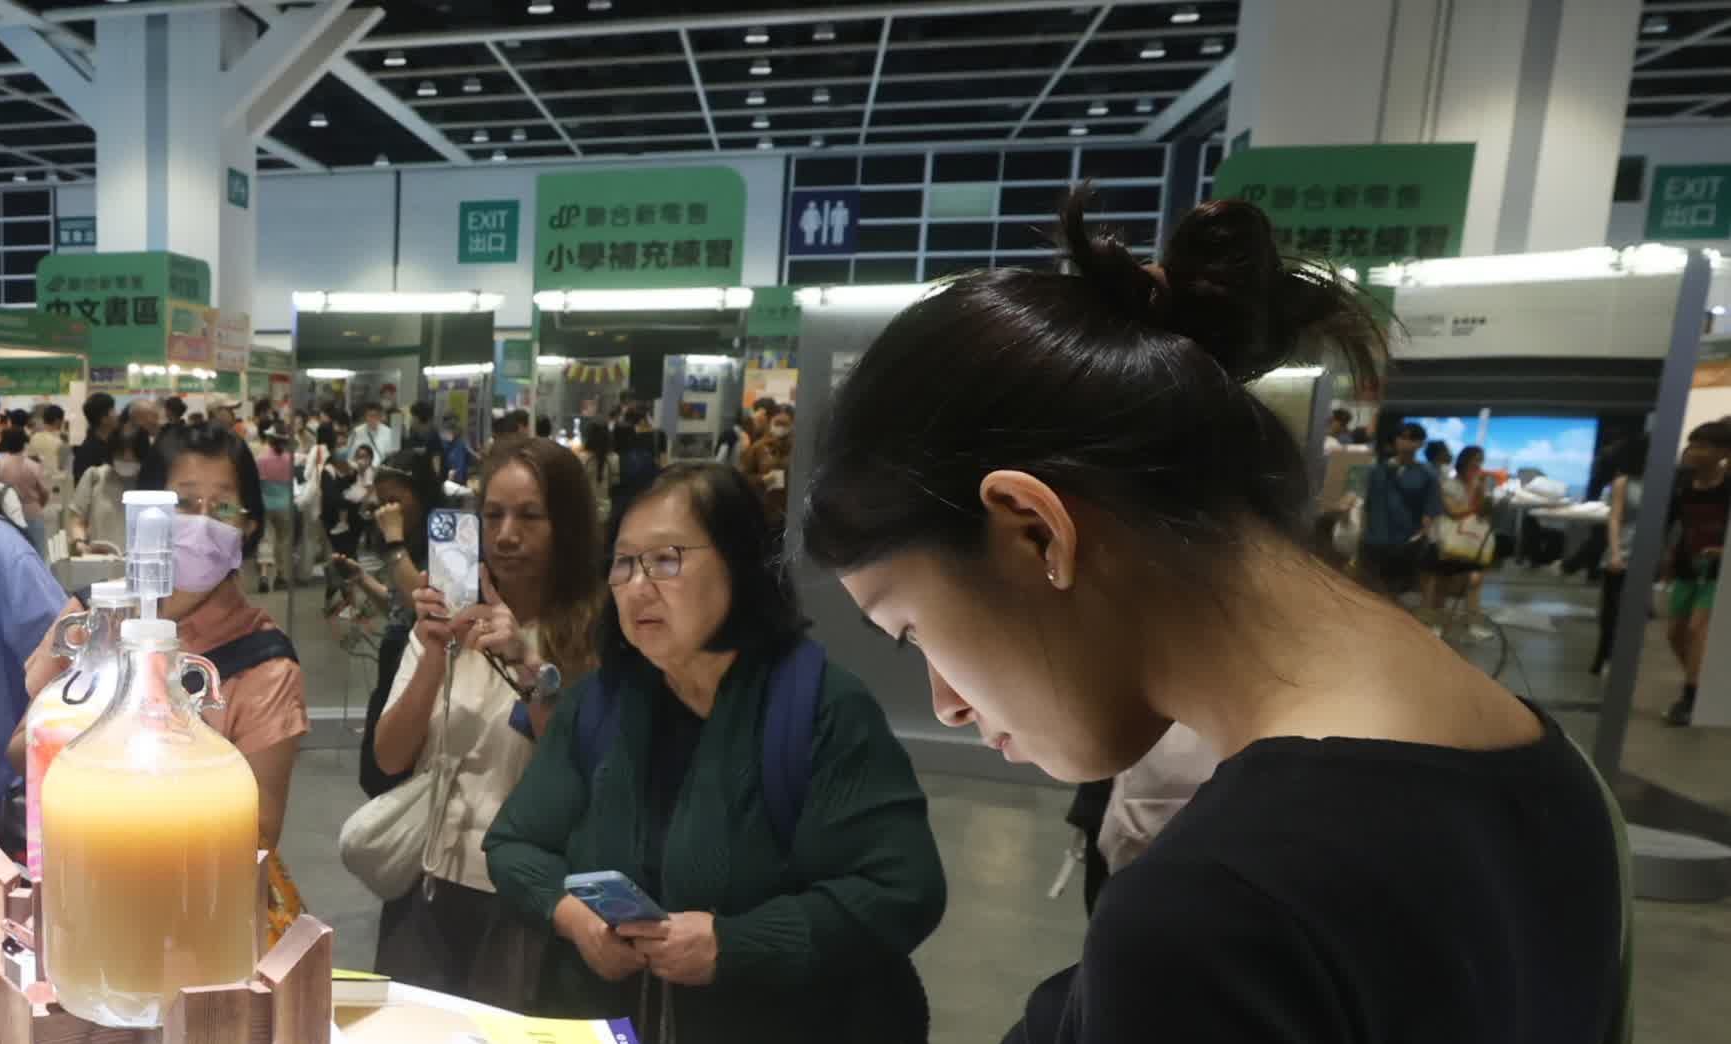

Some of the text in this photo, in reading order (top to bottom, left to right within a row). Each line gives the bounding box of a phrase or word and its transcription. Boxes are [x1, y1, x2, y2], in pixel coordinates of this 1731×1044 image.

[1666, 175, 1724, 201] EXIT
[469, 209, 509, 231] EXIT
[469, 233, 507, 254] 出口
[545, 239, 733, 272] 小學補充練習
